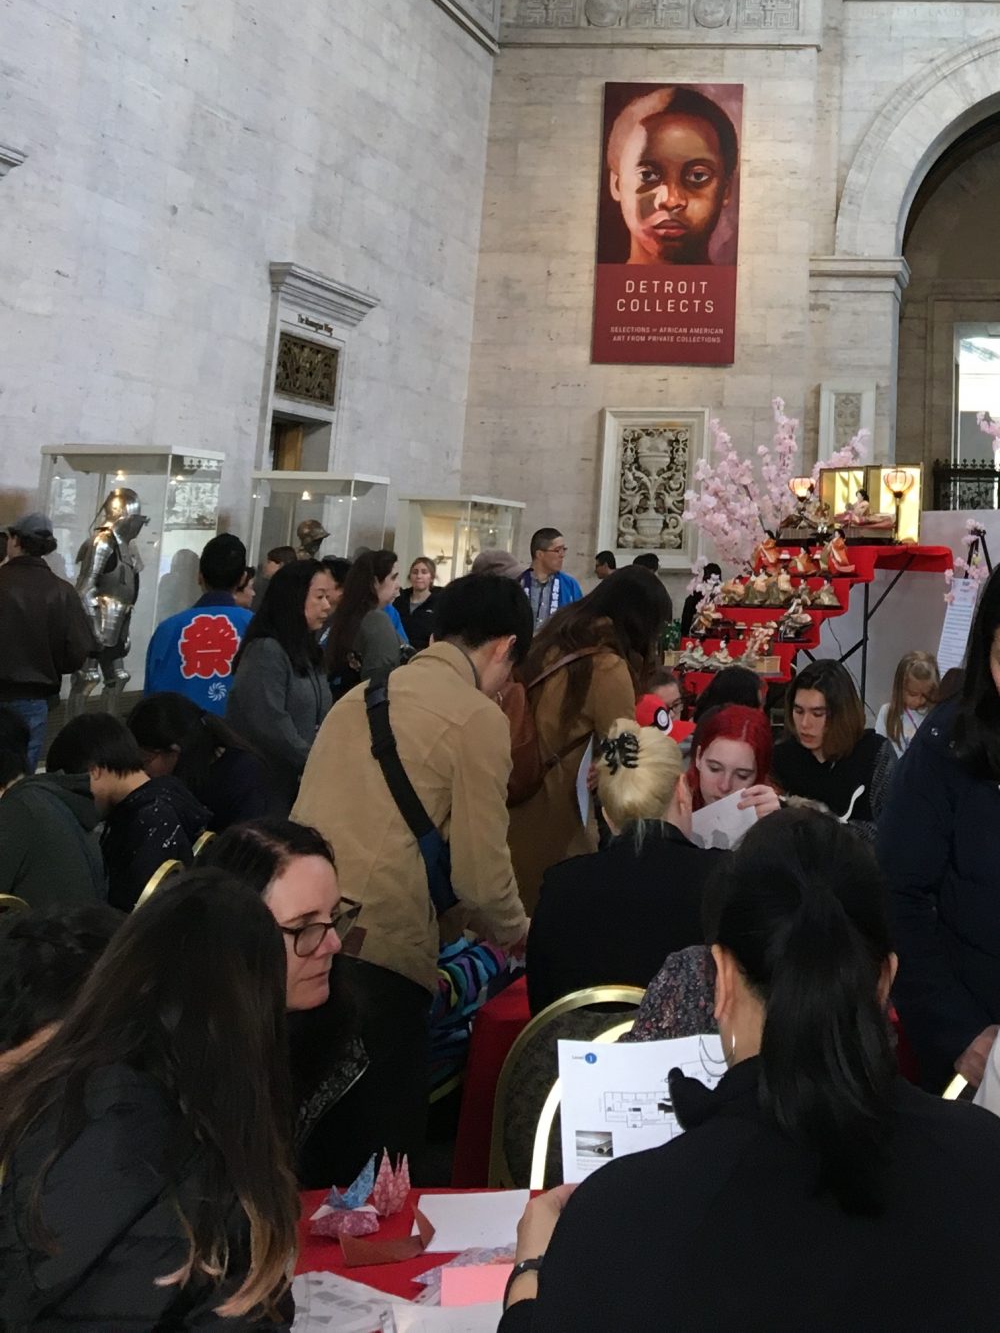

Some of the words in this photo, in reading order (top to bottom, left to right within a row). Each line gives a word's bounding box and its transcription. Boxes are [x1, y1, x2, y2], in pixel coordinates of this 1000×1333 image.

[625, 280, 708, 295] DETROIT
[616, 298, 714, 314] COLLECTS
[610, 326, 650, 334] SELECTIONS
[659, 326, 688, 335] AFRICAN
[689, 327, 724, 335] AMERICAN
[647, 335, 674, 343] PRIVATE
[676, 336, 721, 344] COLLECTIONS
